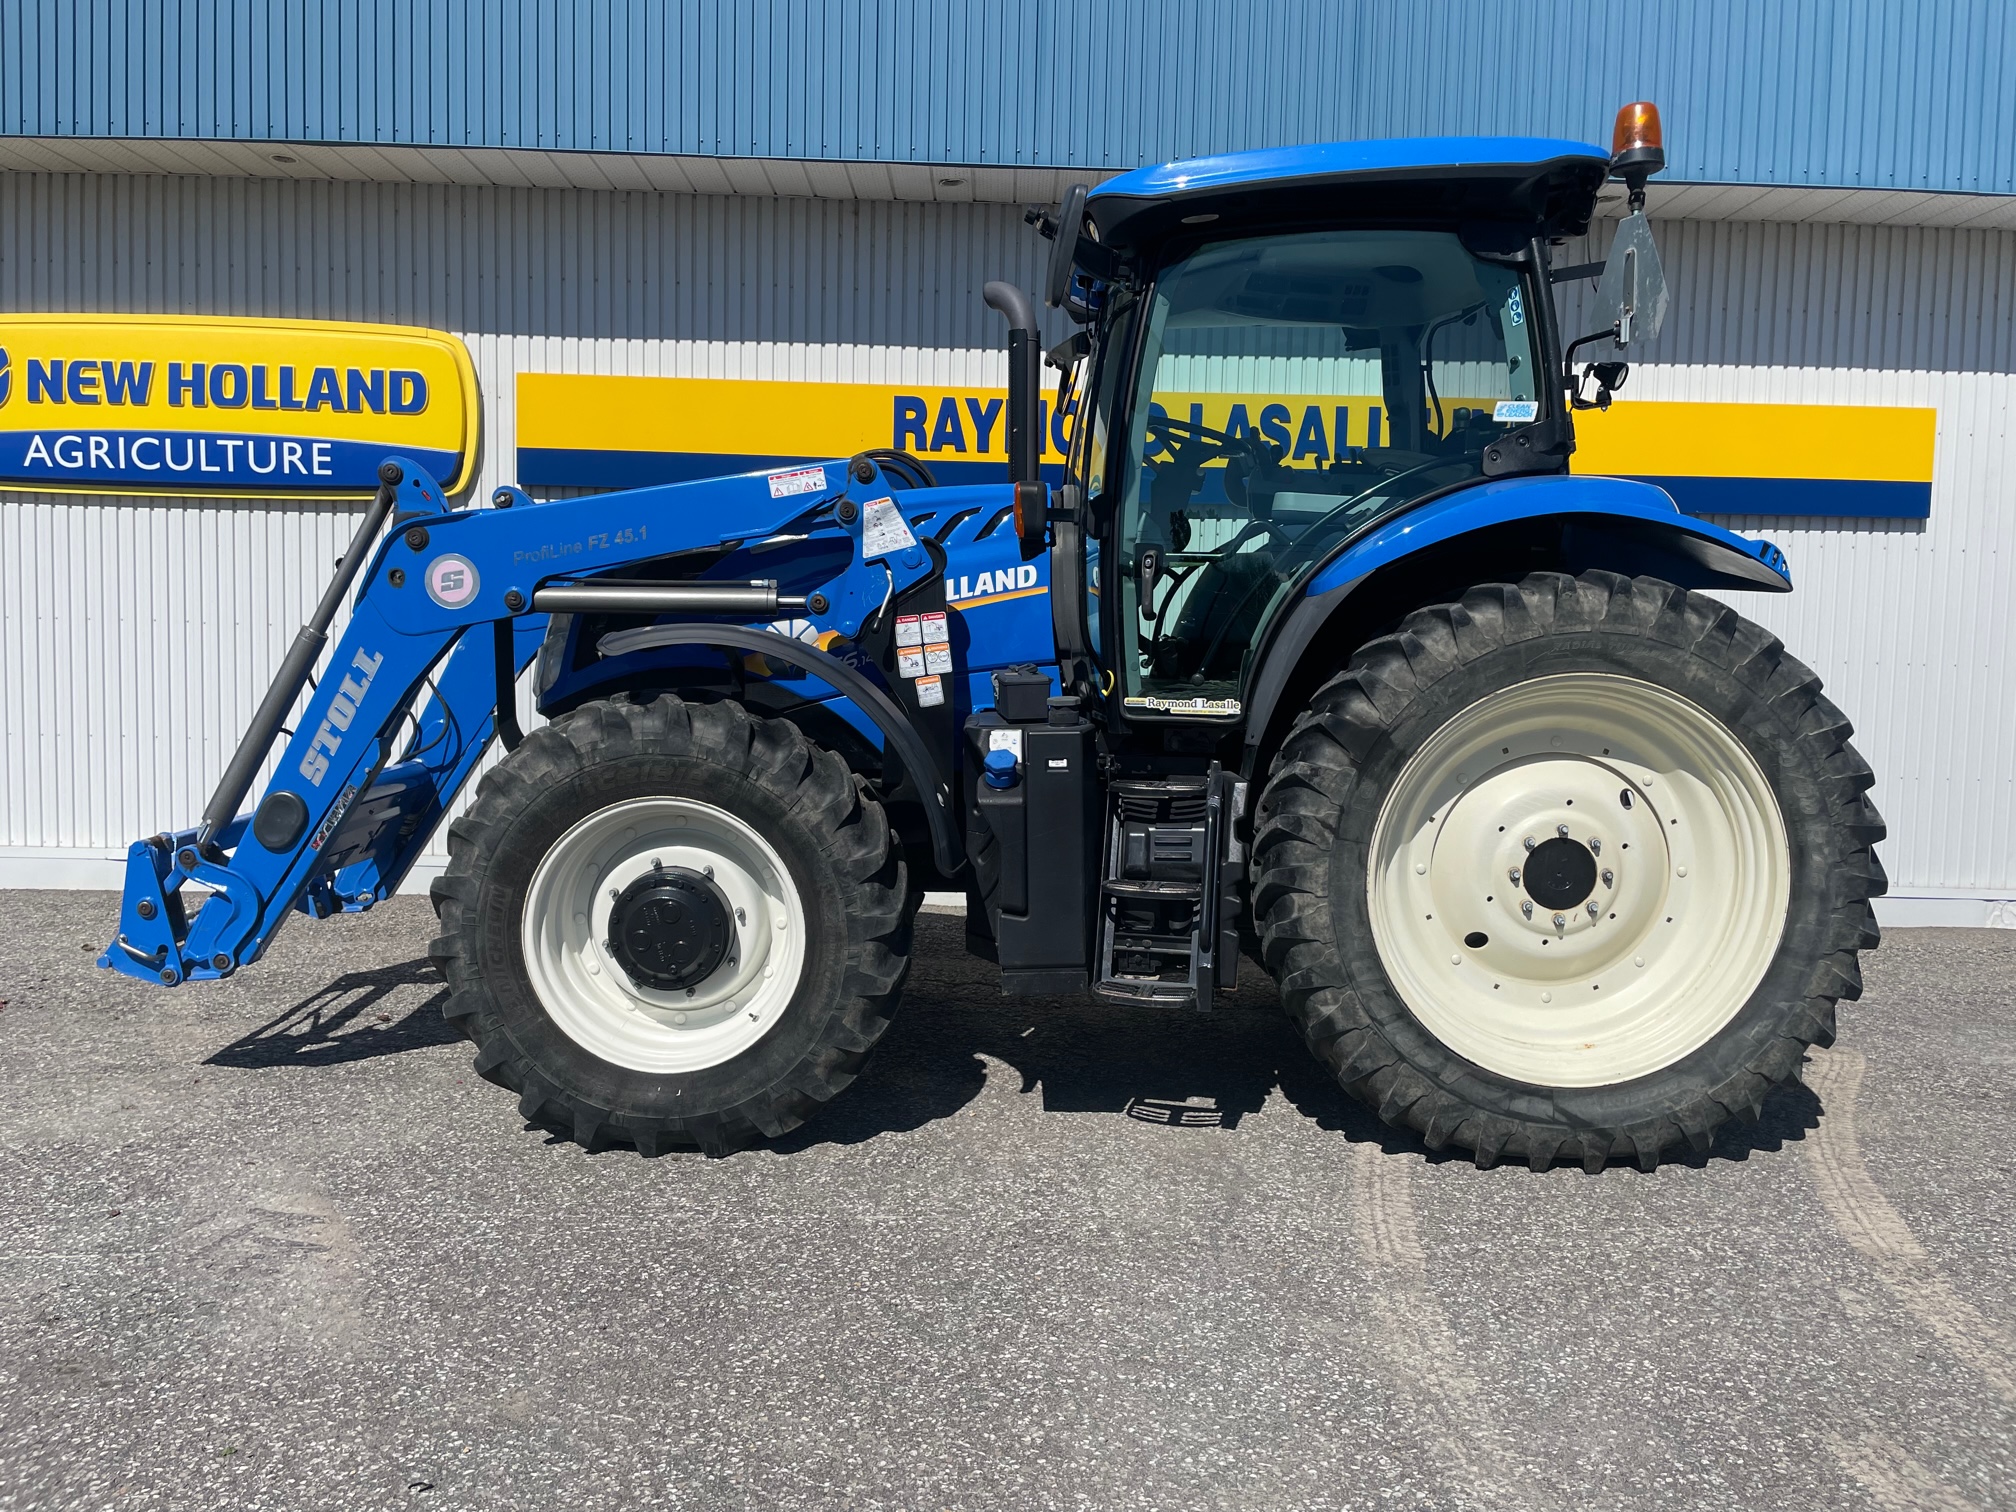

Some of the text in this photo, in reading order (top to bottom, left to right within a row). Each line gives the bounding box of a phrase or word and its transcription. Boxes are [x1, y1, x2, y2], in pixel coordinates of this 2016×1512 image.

[27, 358, 429, 416] NEW HOLLAND
[23, 434, 333, 476] AGRICULTURE
[513, 525, 648, 567] ProfiLine FZ 45.1
[945, 564, 1038, 602] LLAND
[299, 646, 384, 788] STOLL
[1147, 698, 1198, 710] Raymond
[1202, 698, 1240, 710] Lasalle
